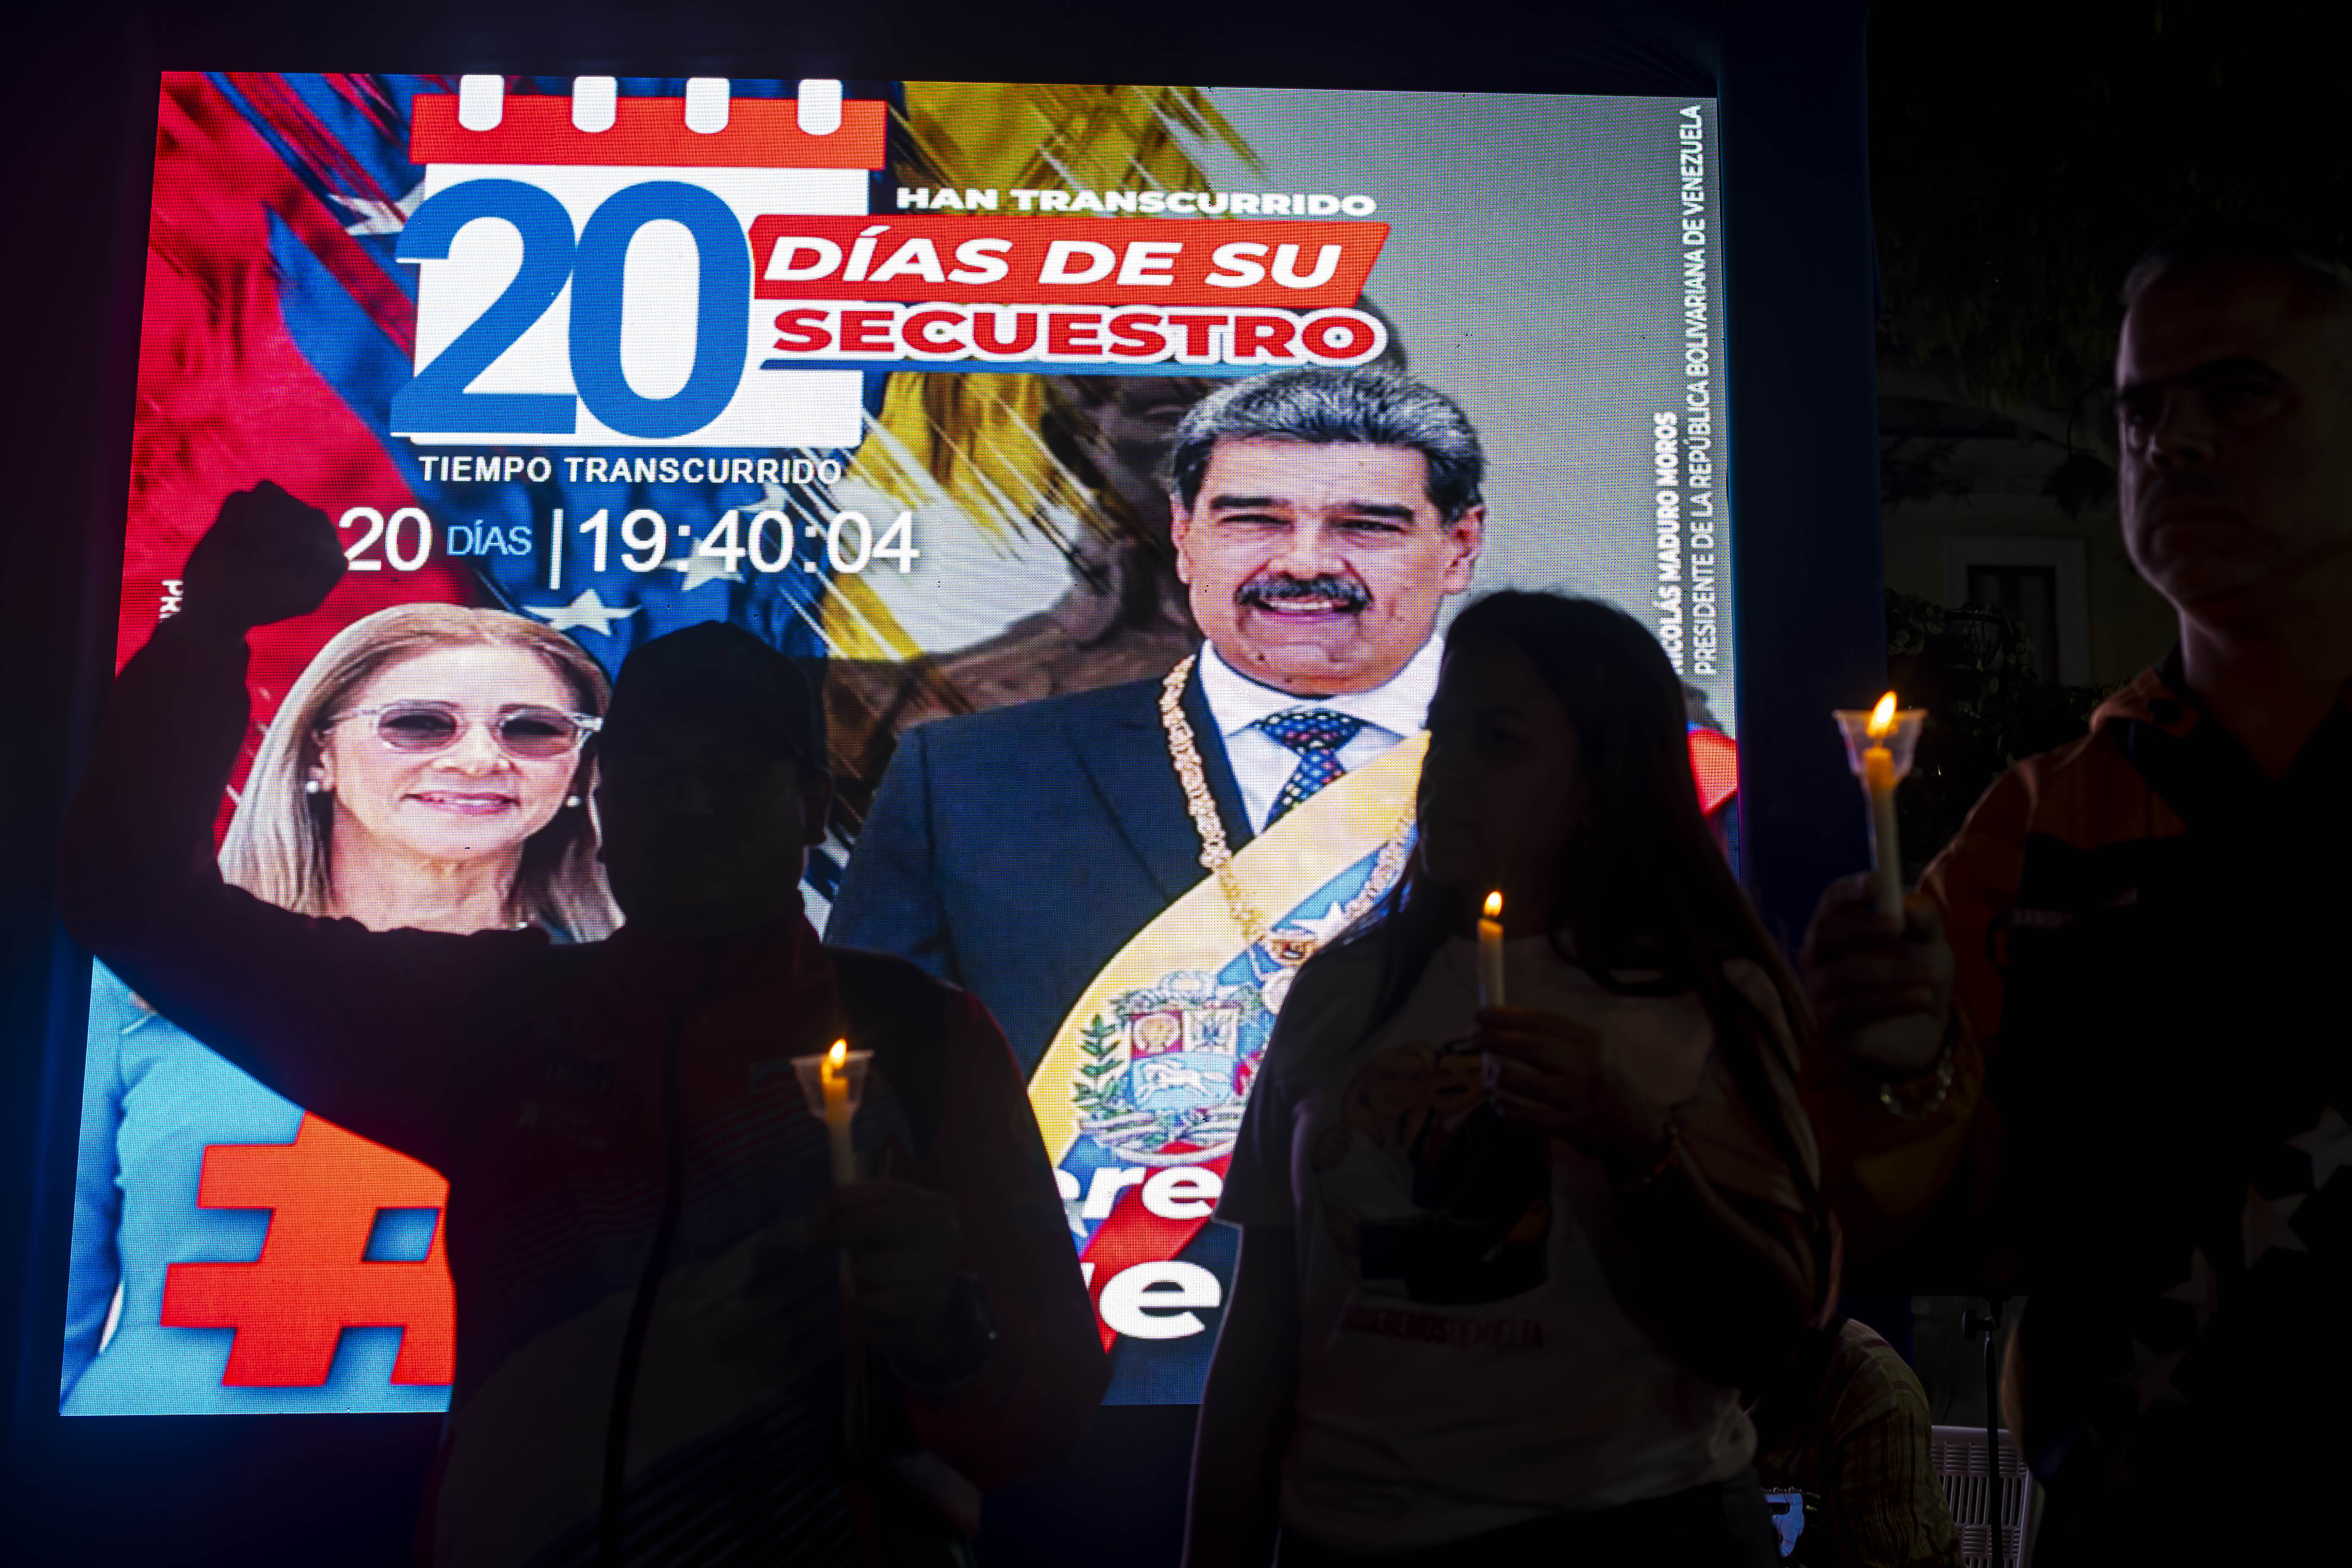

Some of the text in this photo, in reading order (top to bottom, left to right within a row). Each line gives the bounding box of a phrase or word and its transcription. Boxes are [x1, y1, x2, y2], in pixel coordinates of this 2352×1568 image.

[895, 186, 1377, 217] HAN TRANSCURRIDO
[764, 225, 1343, 289] DÍAS DE SU
[390, 177, 751, 439] 20
[772, 308, 1376, 359] SECUESTRO
[1680, 105, 1716, 674] PRESIDENTE DE LA REPÚBLICA BOLIVARIANA DE VENEZUELA
[418, 455, 842, 484] TIEMPO TRANSCURRIDO
[1655, 411, 1680, 487] MOROS
[338, 507, 920, 573] 20 DÍAS 19:40:04
[1656, 490, 1682, 581] MADURO
